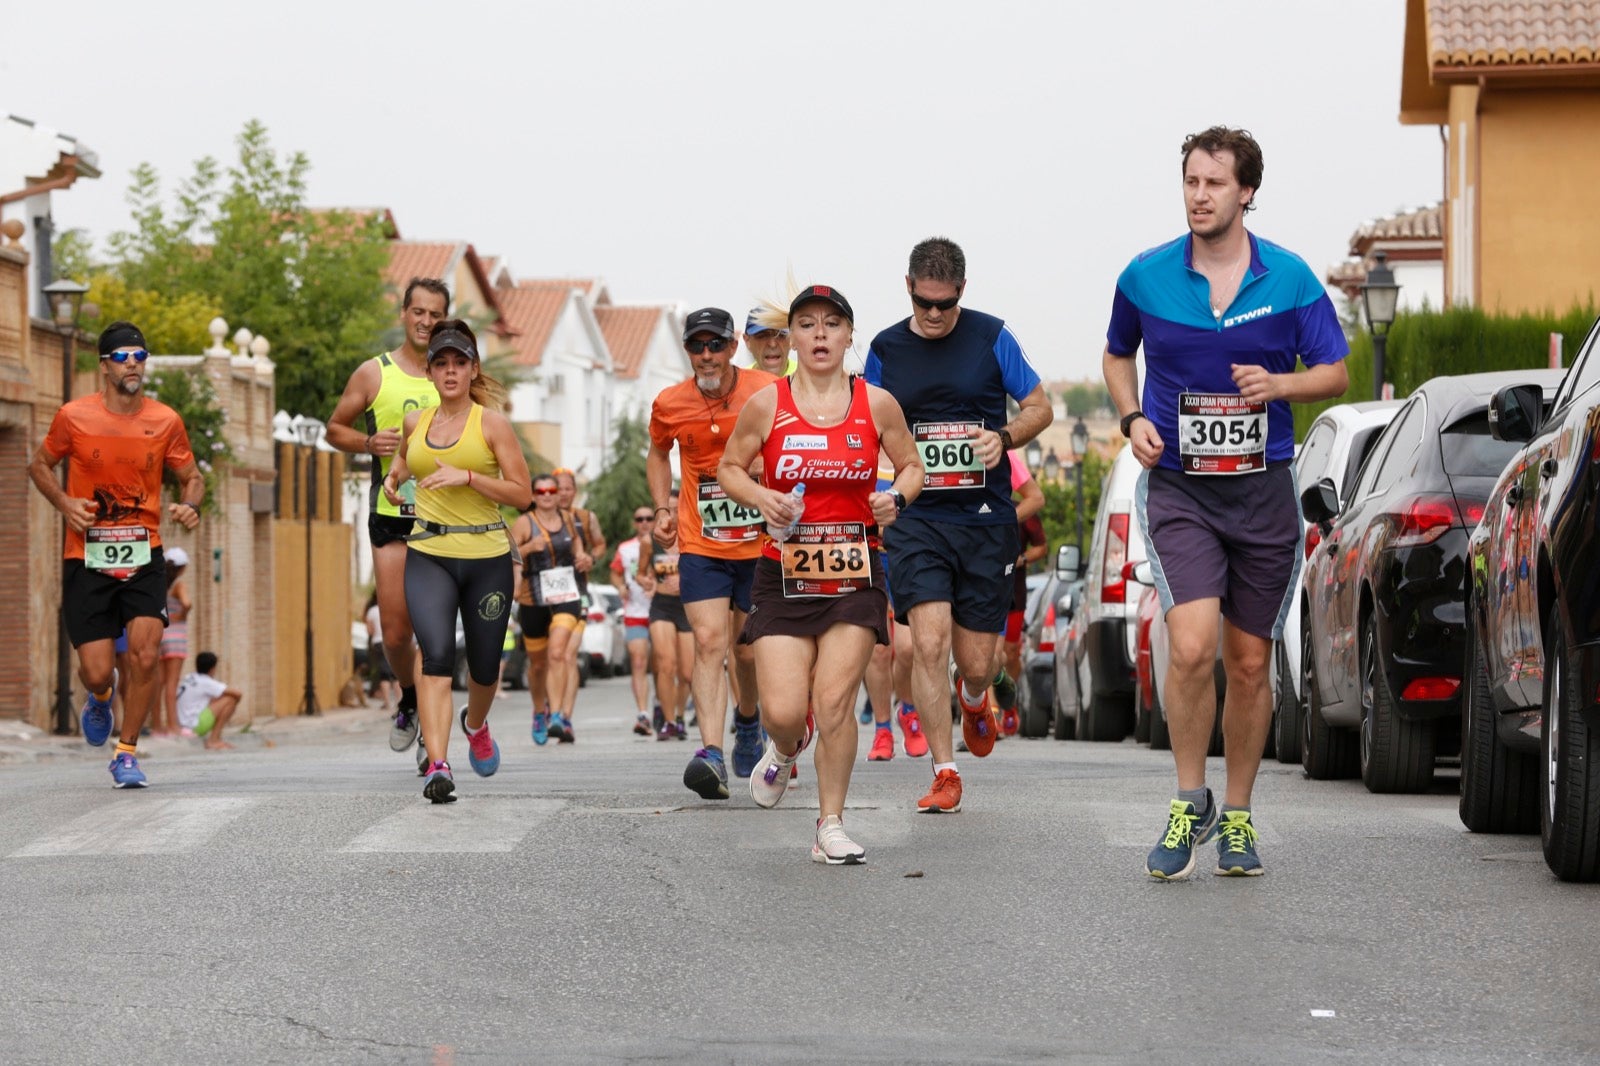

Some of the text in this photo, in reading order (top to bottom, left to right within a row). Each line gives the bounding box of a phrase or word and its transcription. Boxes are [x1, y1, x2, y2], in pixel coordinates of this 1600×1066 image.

[1200, 396, 1217, 406] GRAN
[1217, 396, 1239, 407] PREMIO
[1190, 418, 1262, 446] 3054
[775, 454, 872, 480] Polisalud
[925, 443, 974, 468] 960
[800, 526, 815, 535] GRAN
[815, 526, 835, 535] PREMIO
[836, 526, 843, 535] DE
[844, 525, 860, 534] FONDO
[104, 545, 134, 564] 92
[793, 547, 864, 572] 2138
